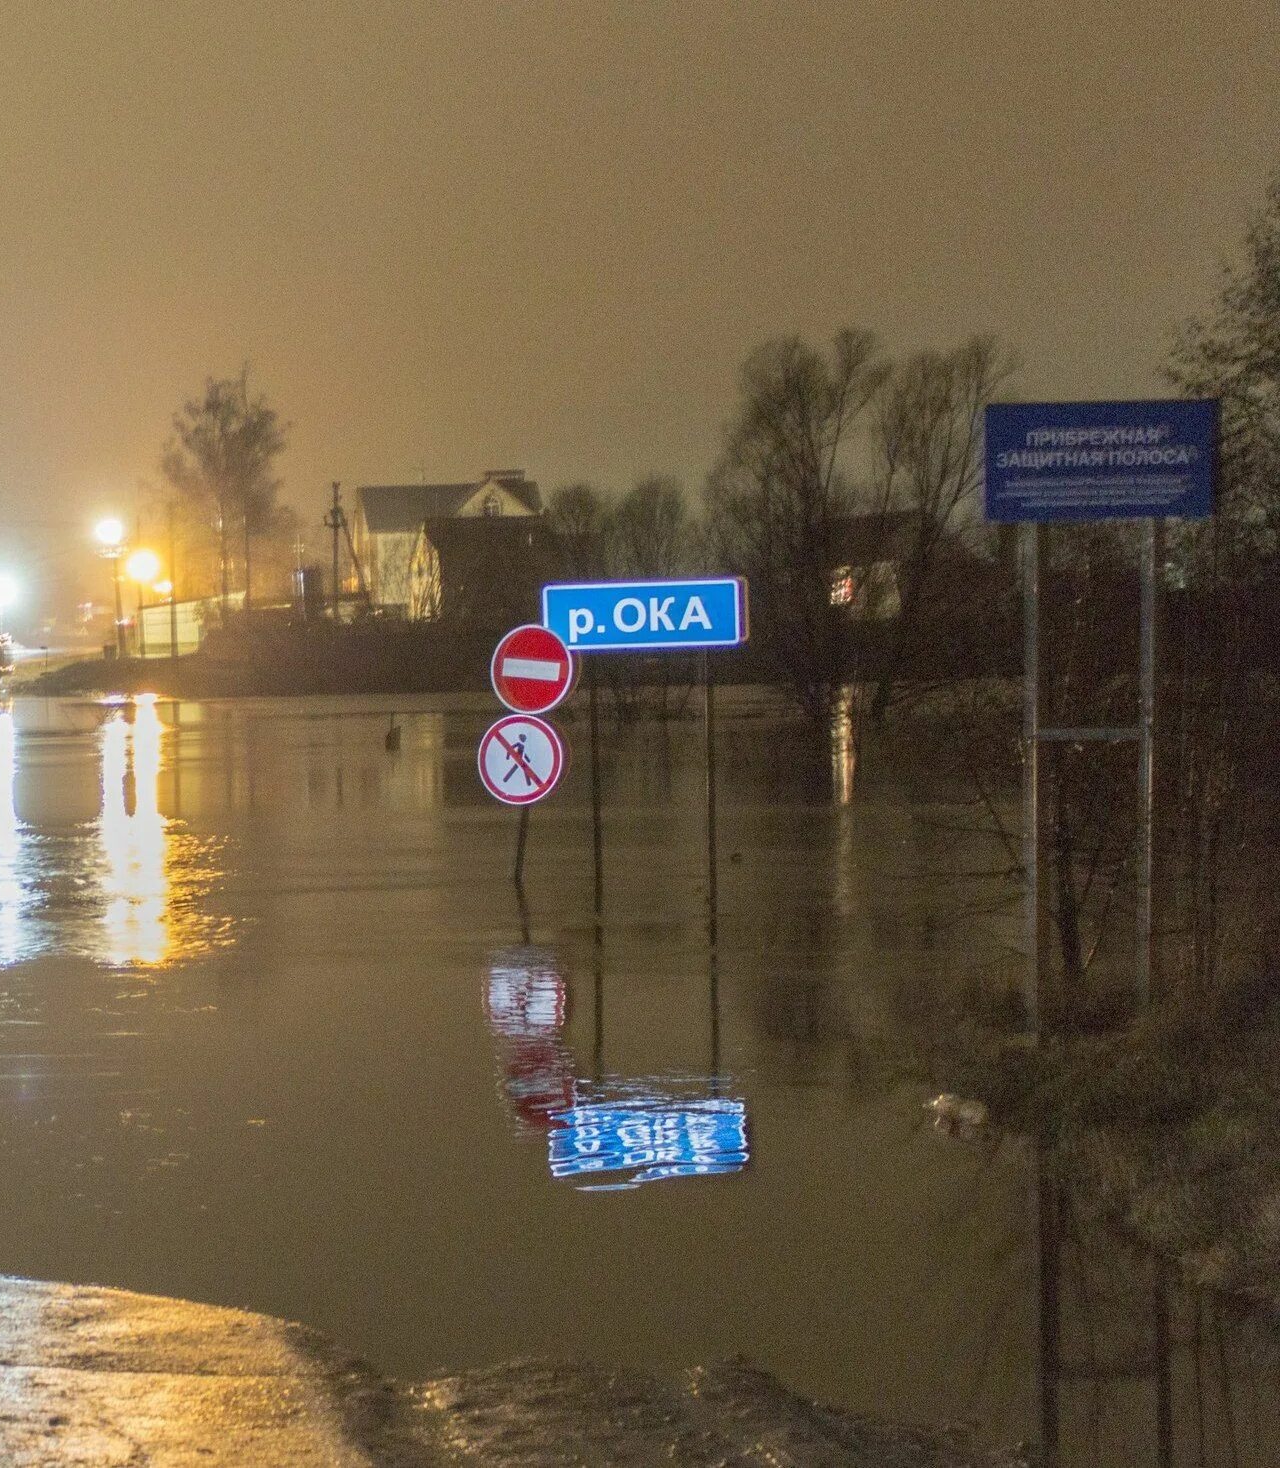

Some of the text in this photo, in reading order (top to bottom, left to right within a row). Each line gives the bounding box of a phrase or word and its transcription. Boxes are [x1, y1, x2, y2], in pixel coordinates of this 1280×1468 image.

[1026, 428, 1161, 447] ПРИБРЕЖНАЯ
[996, 448, 1189, 469] ЗАЩИТНАЯ ПОЛОСА
[613, 596, 713, 633] ОКА
